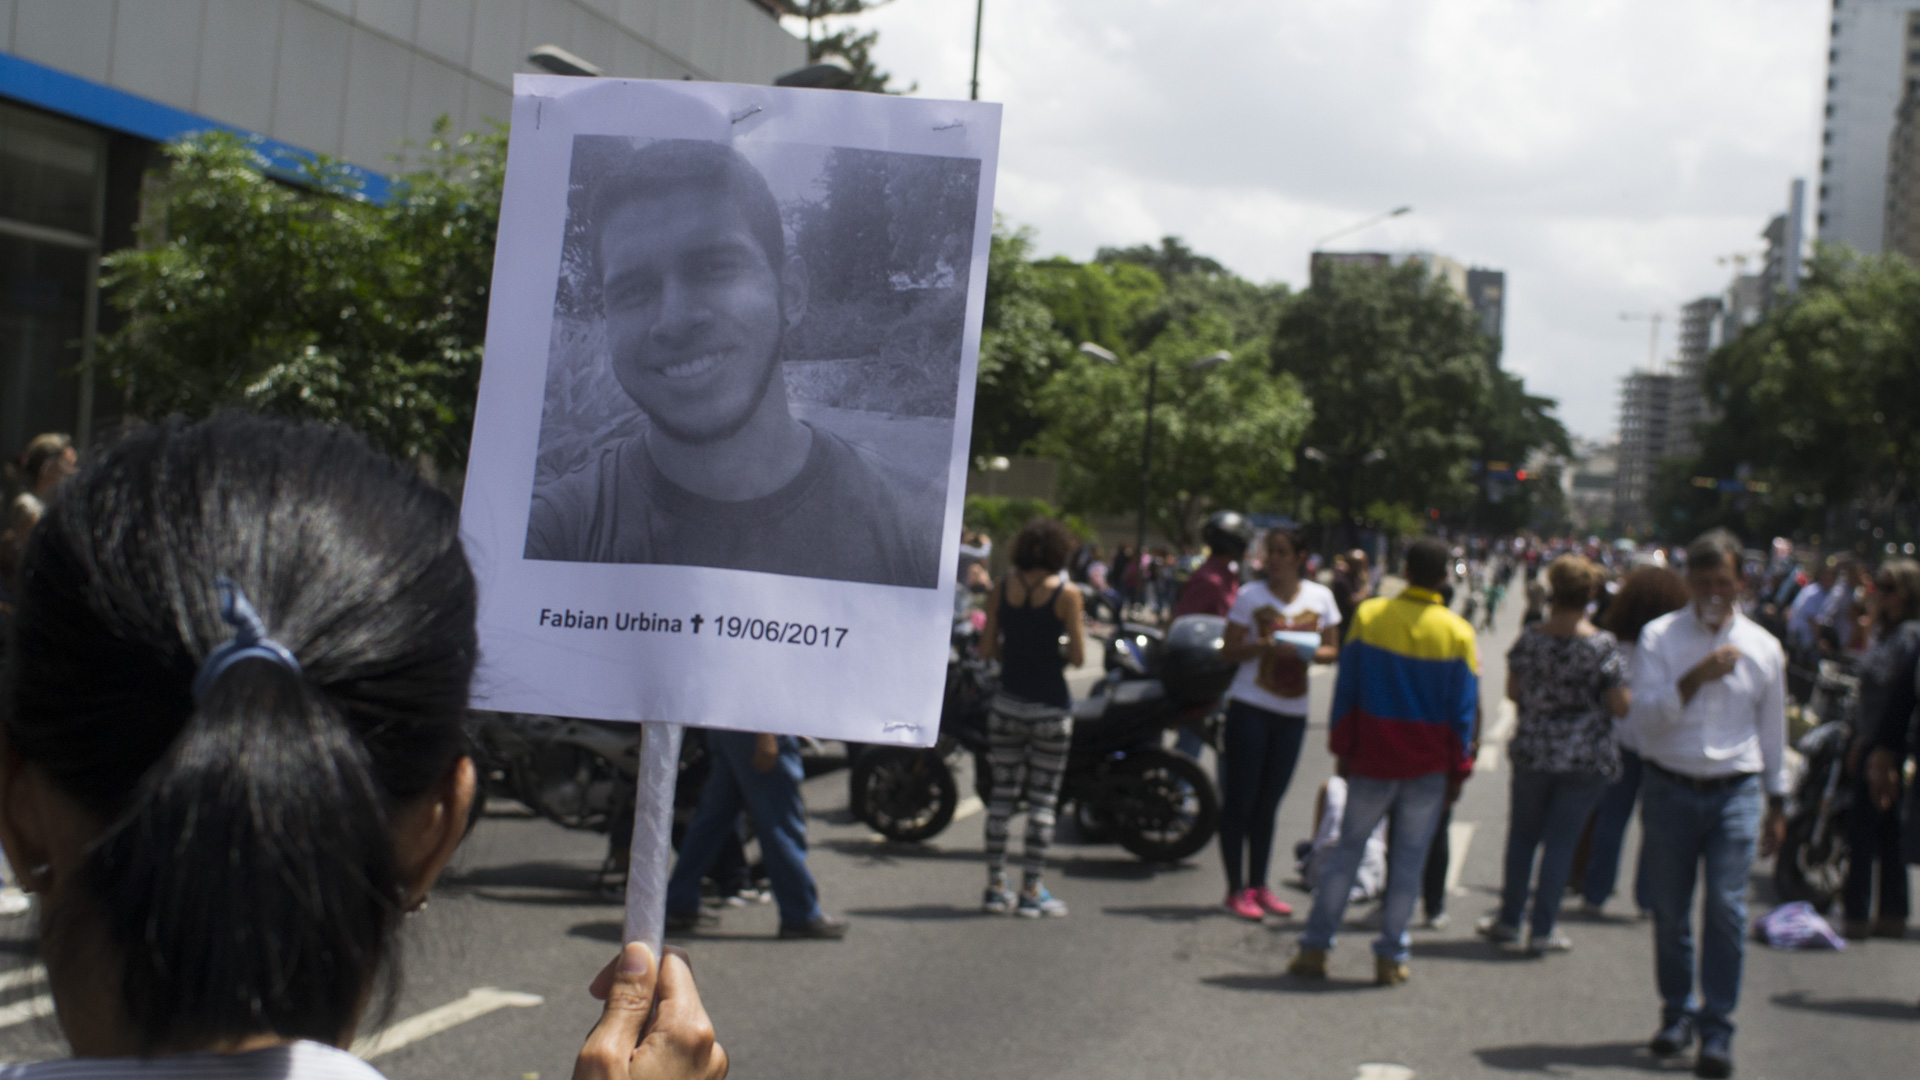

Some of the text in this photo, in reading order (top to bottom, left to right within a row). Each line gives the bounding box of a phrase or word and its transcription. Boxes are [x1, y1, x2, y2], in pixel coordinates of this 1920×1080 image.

[539, 608, 849, 649] Fabian Urbina 19/06/2017
